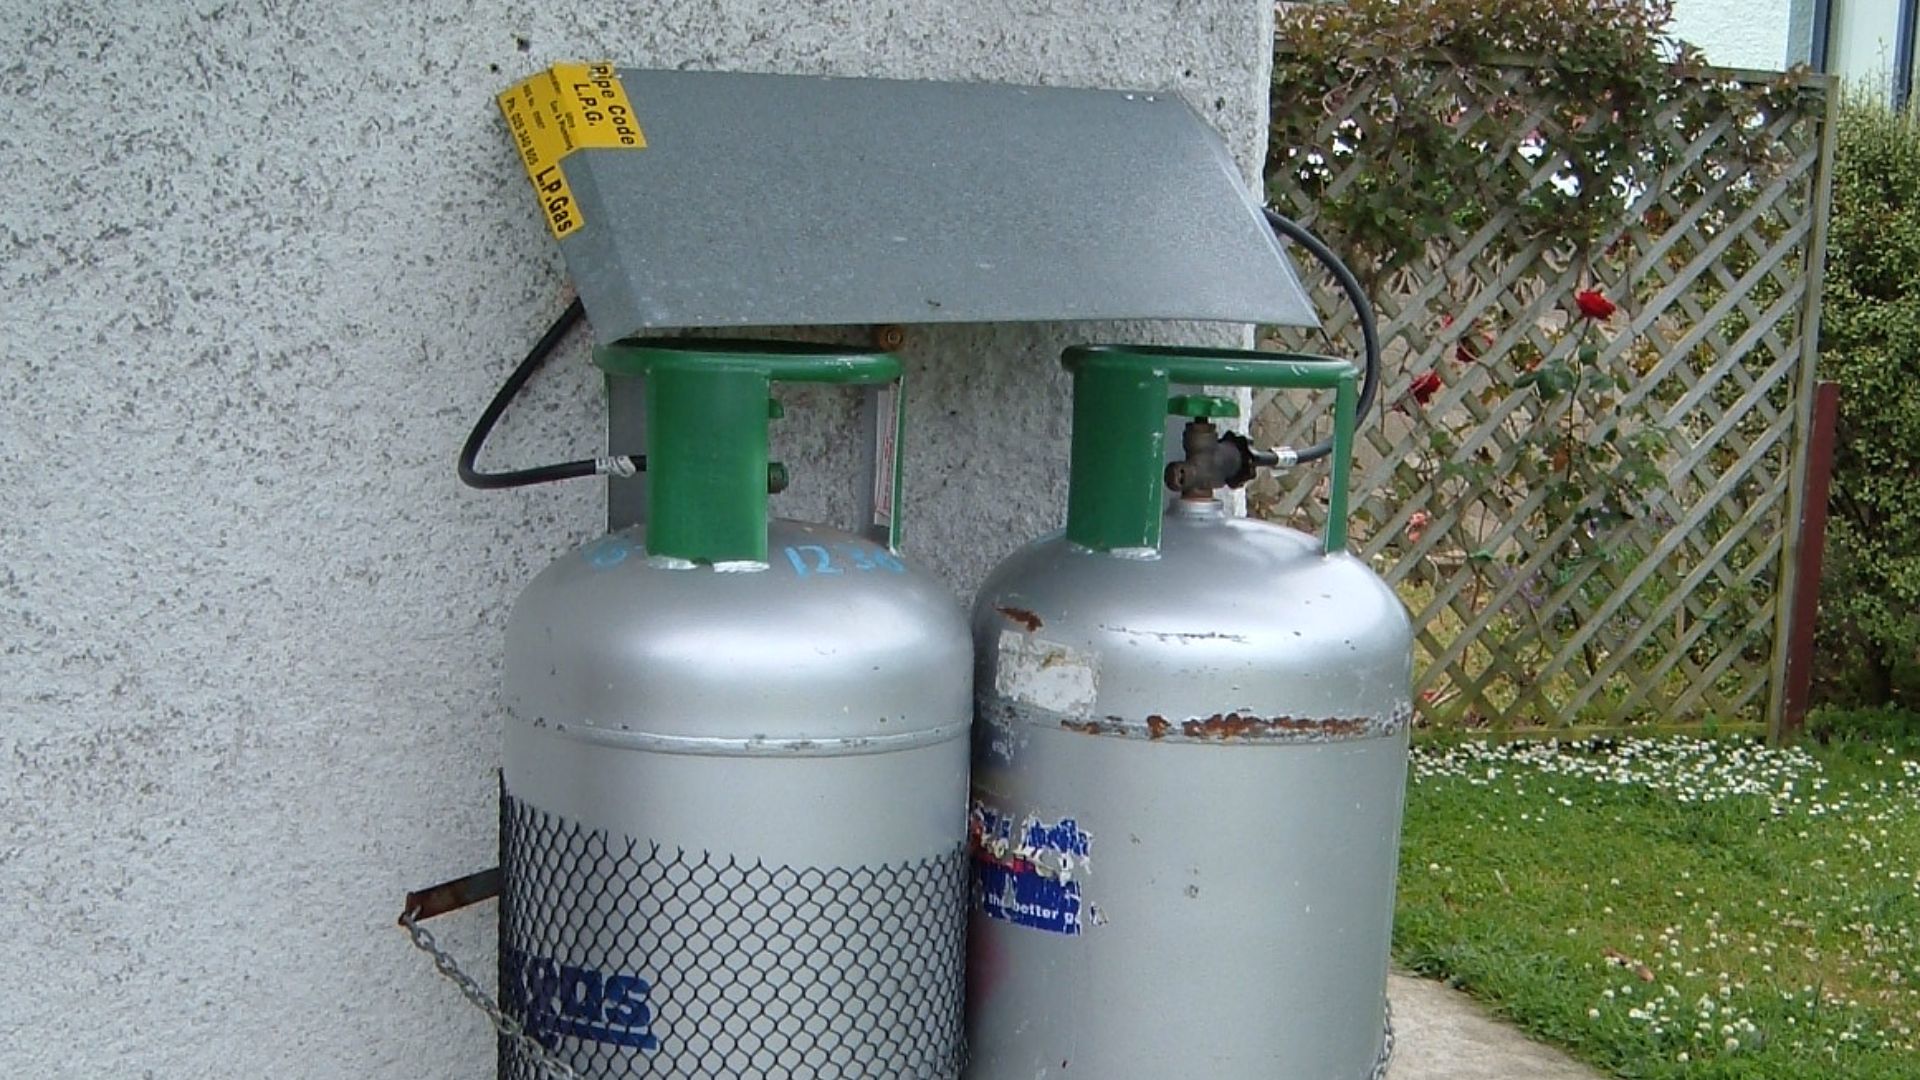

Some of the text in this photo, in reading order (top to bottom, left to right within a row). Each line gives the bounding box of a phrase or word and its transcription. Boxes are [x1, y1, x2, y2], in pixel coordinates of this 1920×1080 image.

[573, 82, 604, 127] L.P.G.
[590, 63, 635, 146] Pipe Code
[535, 165, 574, 233] L.P.Gas
[1013, 900, 1059, 920] better
